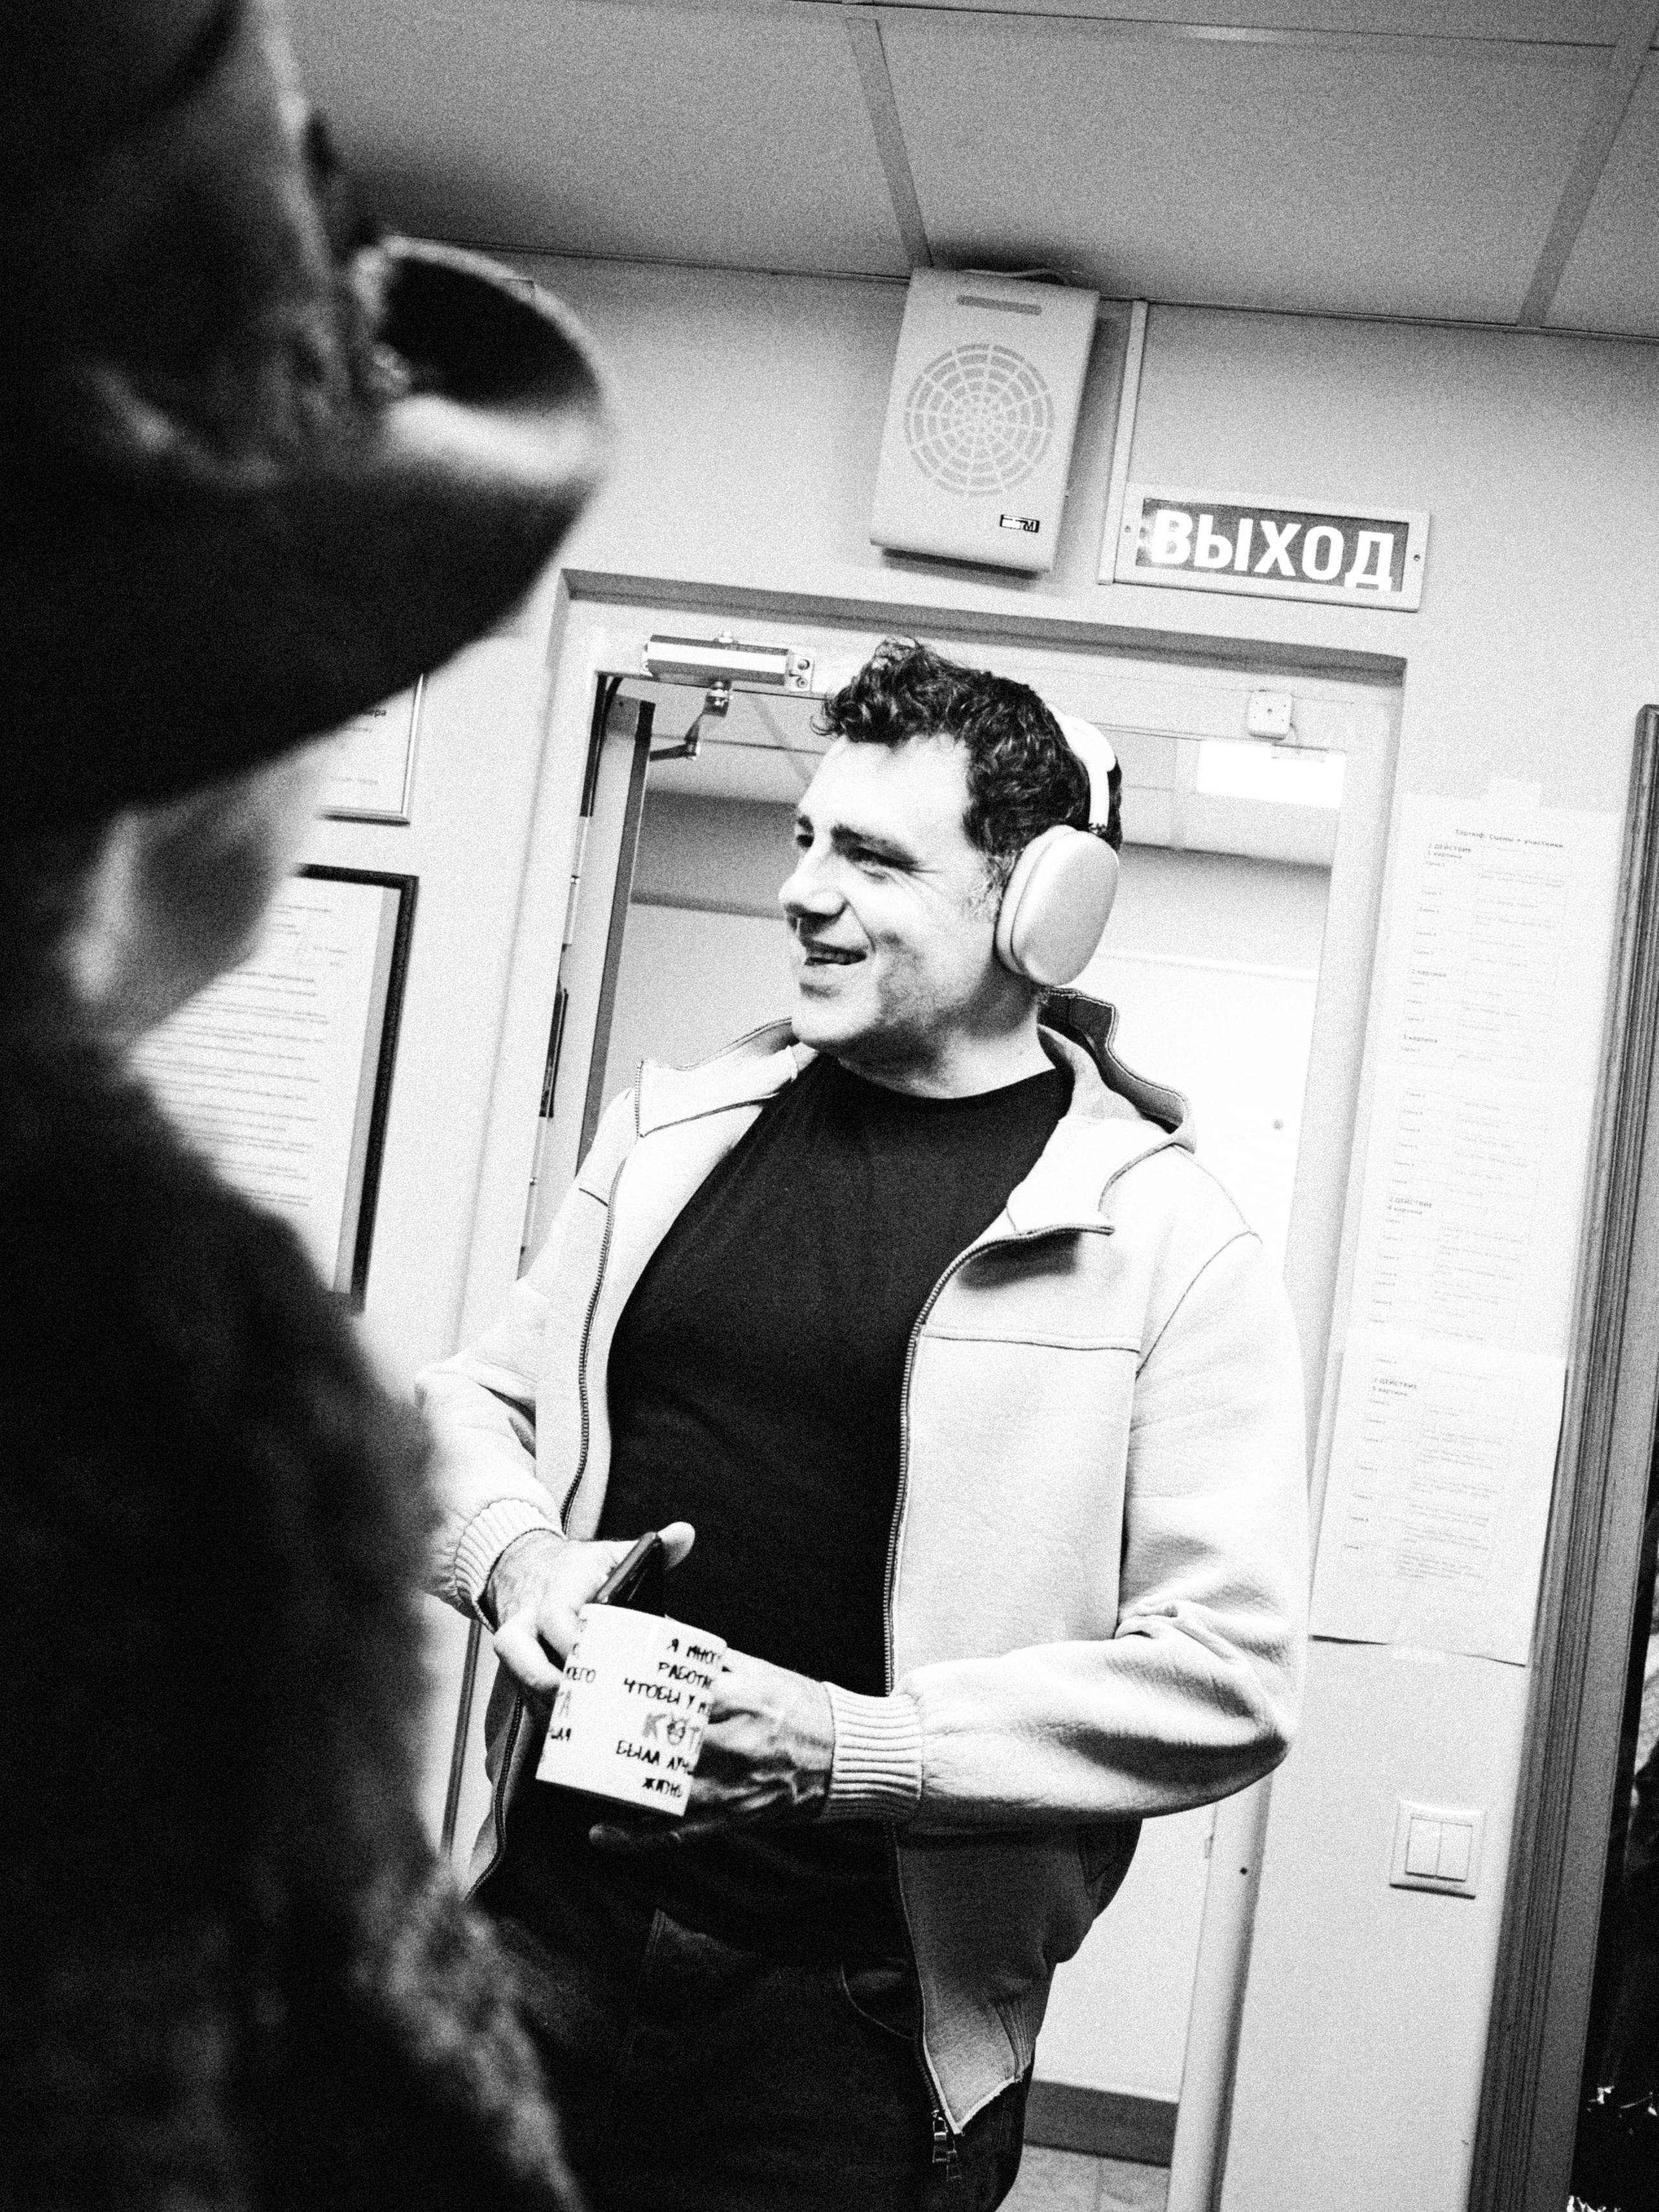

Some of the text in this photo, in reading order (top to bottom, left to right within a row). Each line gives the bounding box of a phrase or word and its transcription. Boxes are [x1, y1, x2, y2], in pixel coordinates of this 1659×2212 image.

[1151, 509, 1394, 591] ВЫХОД
[666, 1638, 679, 1652] Я
[624, 1677, 681, 1705] ЧТОБЫ
[616, 1740, 660, 1765] БЫЛА
